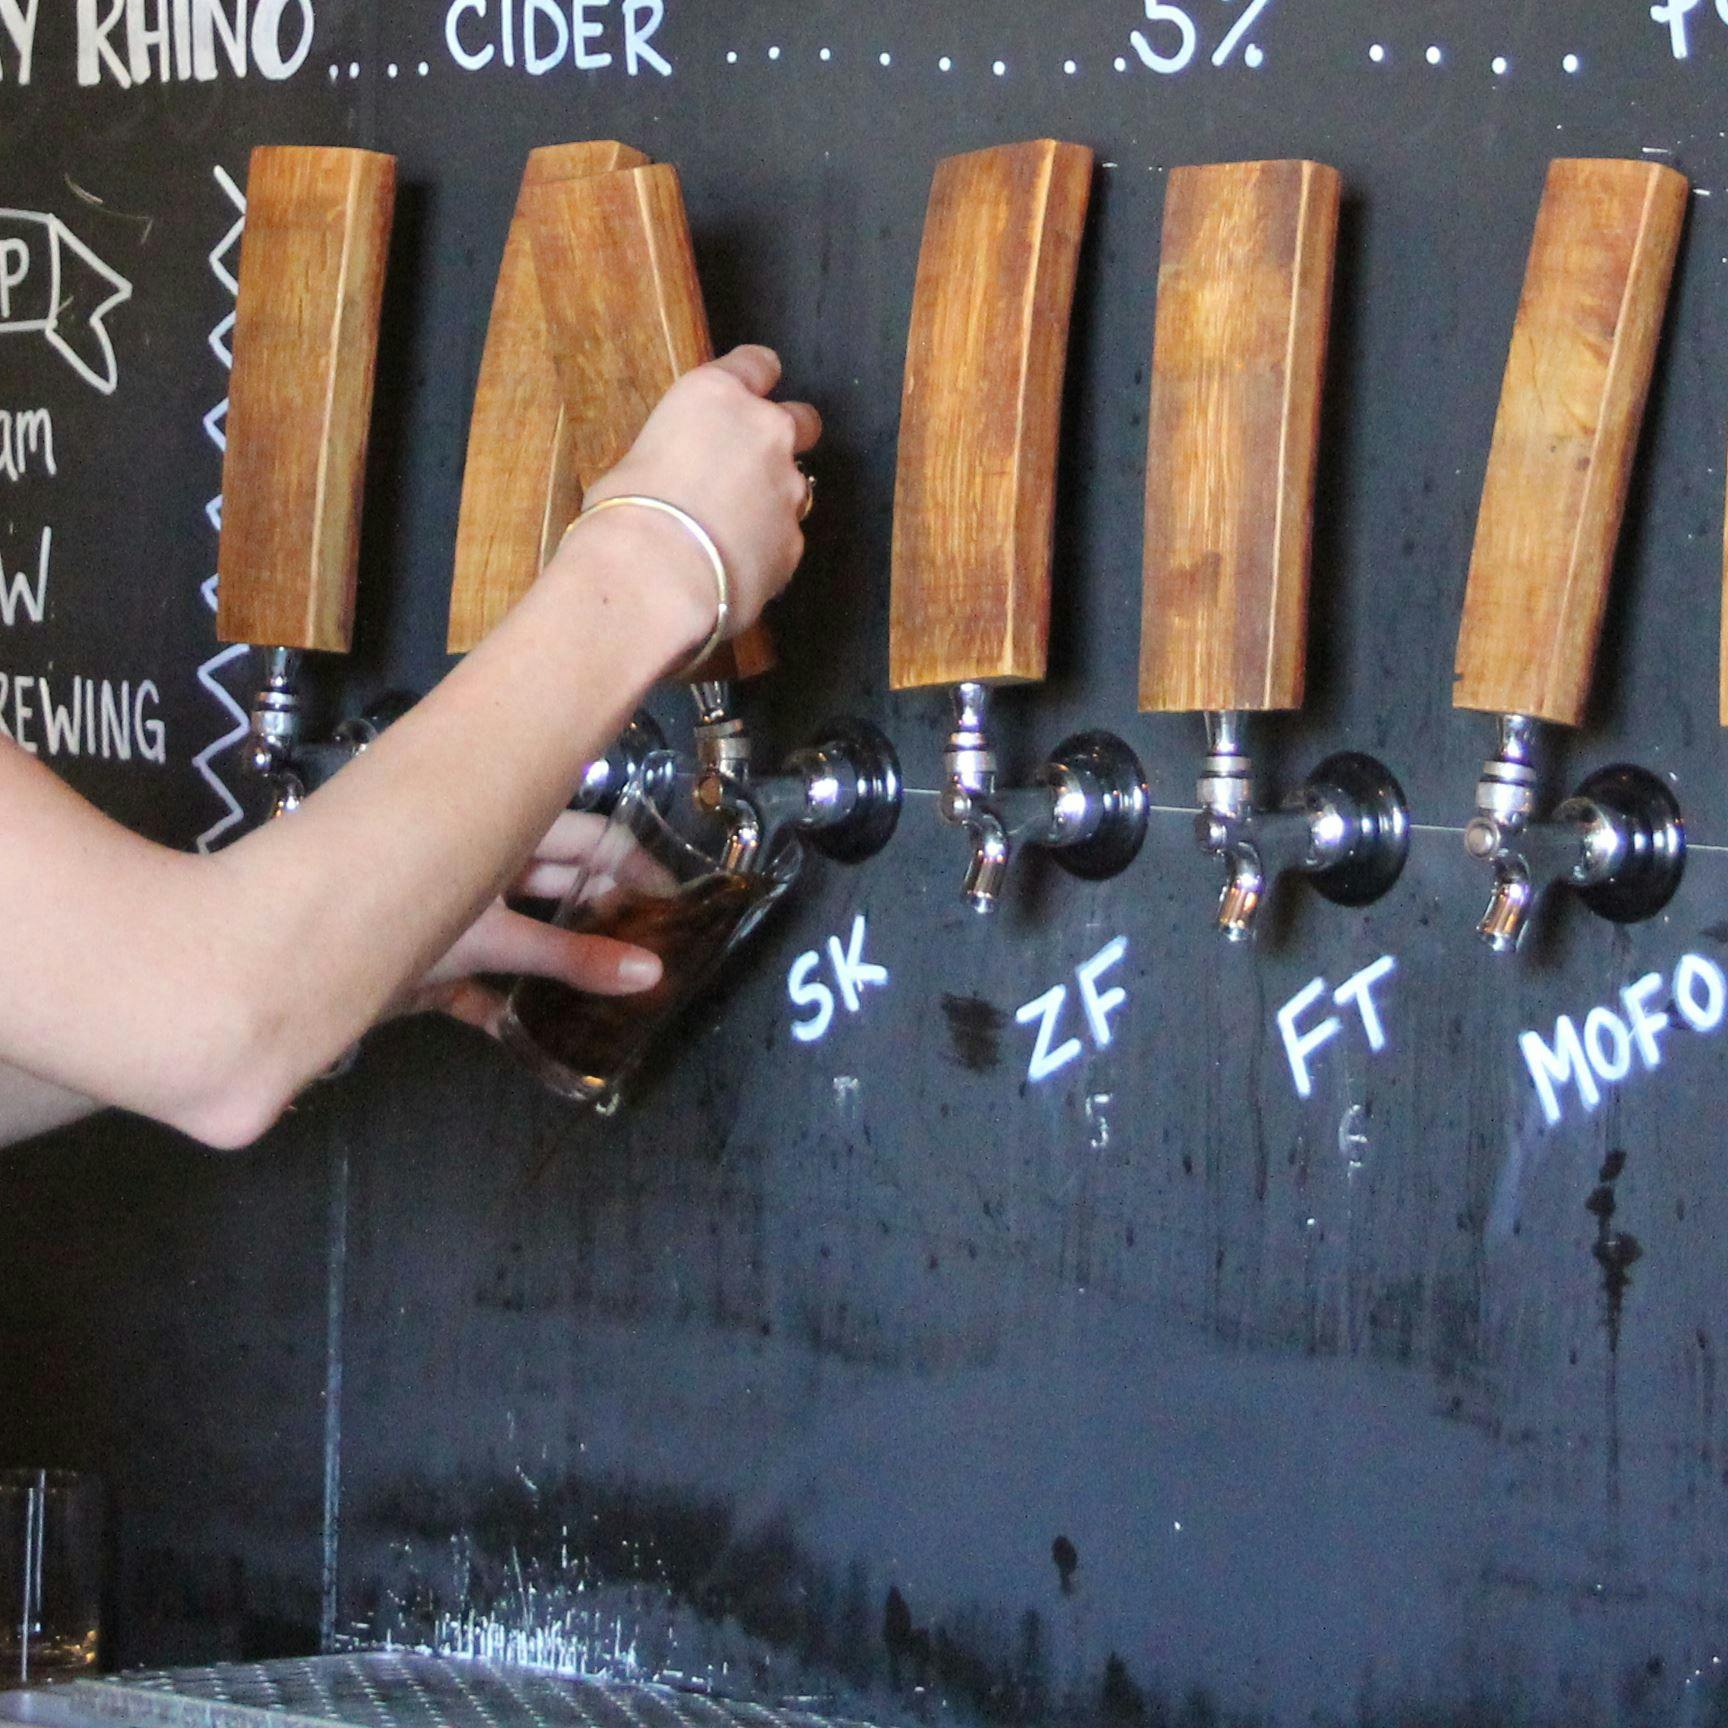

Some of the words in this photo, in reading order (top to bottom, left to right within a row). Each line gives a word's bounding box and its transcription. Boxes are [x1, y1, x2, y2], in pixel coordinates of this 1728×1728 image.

[787, 914, 889, 1043] SK
[1014, 935, 1128, 1082] ZF
[1276, 954, 1395, 1097] FT
[1518, 952, 1728, 1126] MOFO
